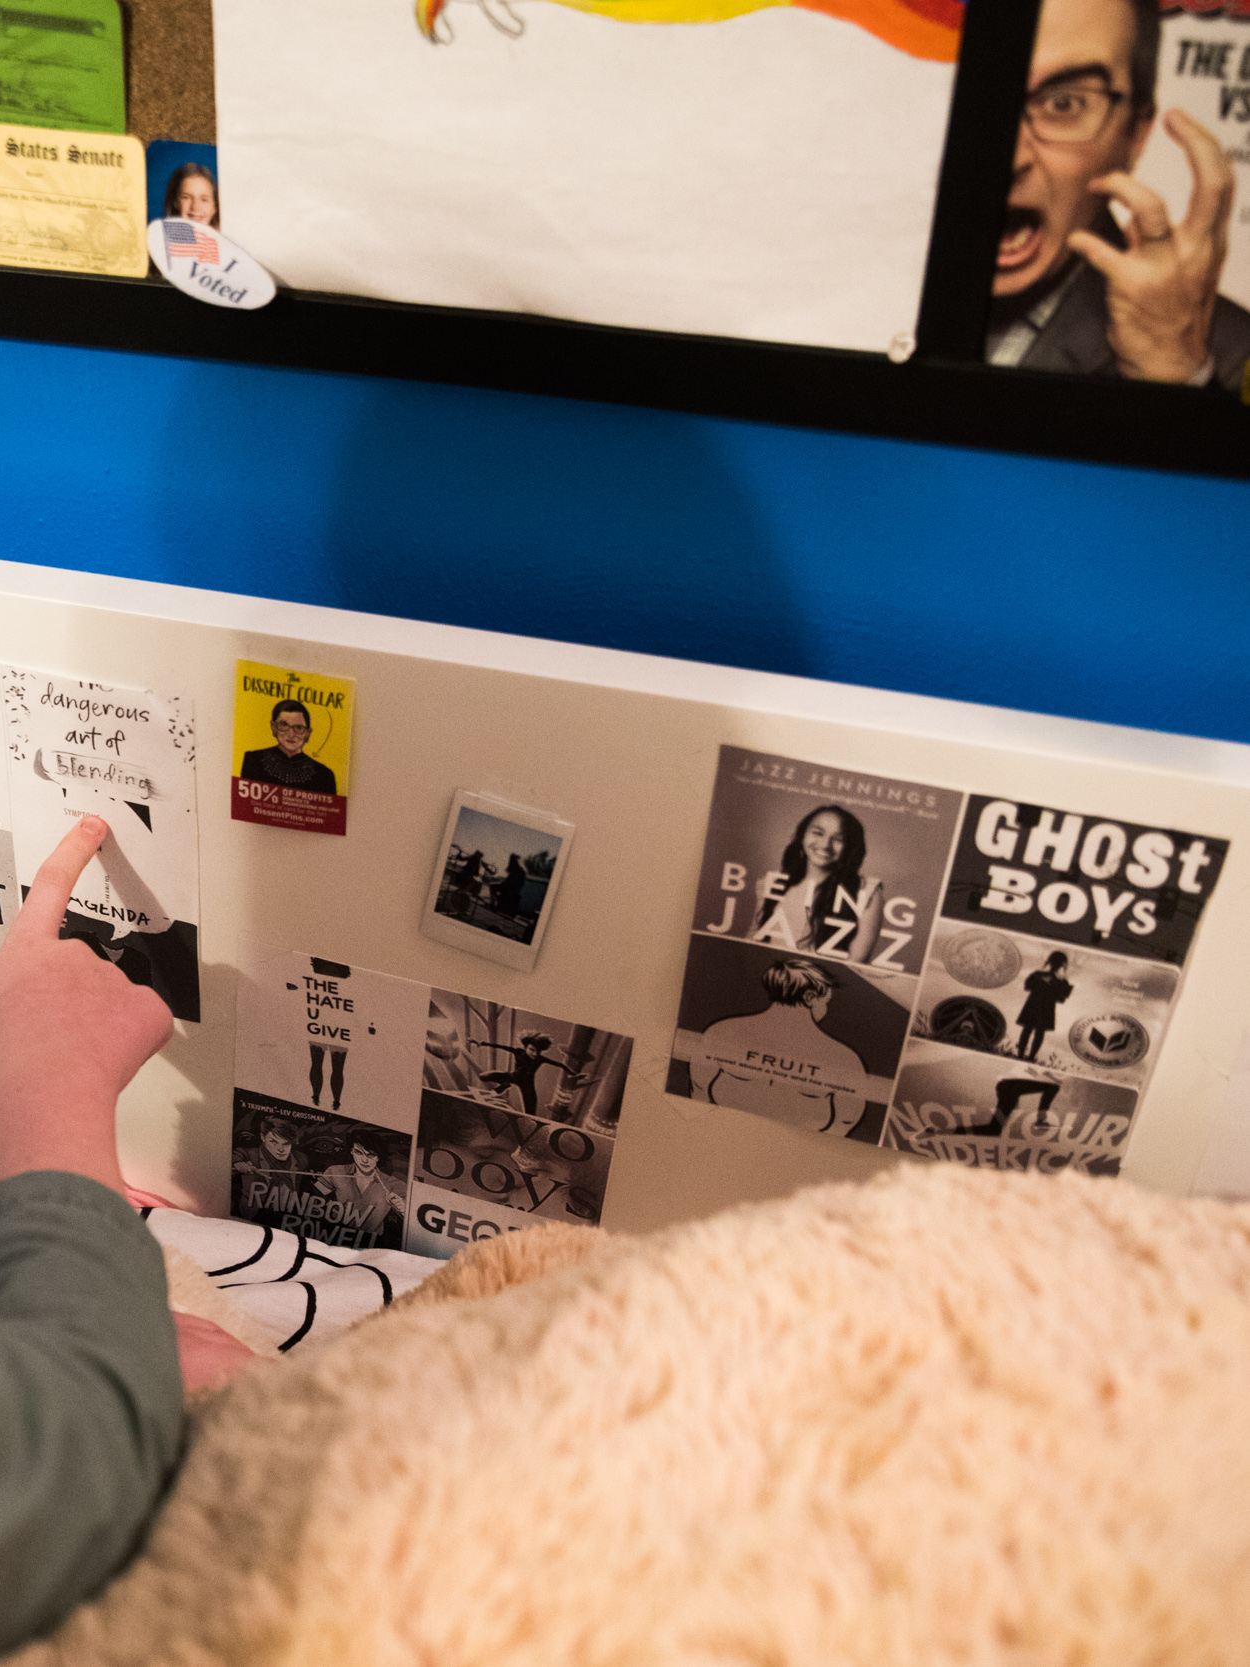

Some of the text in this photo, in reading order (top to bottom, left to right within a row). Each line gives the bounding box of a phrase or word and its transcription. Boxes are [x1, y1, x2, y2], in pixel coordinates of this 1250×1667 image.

[1177, 39, 1231, 80] THE
[5, 137, 59, 162] States
[65, 143, 125, 168] Senate
[223, 257, 238, 273] I
[189, 261, 248, 304] Voted
[40, 681, 150, 722] dangerous
[243, 675, 345, 710] DISSENT COLLAR
[65, 726, 126, 756] art of
[56, 754, 153, 800] blending
[238, 780, 333, 804] 50% OF PROFITS
[740, 758, 797, 780] JAZZ
[807, 770, 938, 808] JENNINGS
[253, 807, 324, 825] DissentPins.com
[720, 861, 917, 928] BEING
[706, 897, 913, 972] JAZZ
[302, 976, 338, 995] THE
[306, 992, 354, 1013] HATE
[307, 1007, 320, 1020] U
[306, 1022, 351, 1042] GIVE
[713, 1057, 737, 1065] novel
[738, 1062, 763, 1072] about
[772, 1070, 788, 1079] boy
[790, 1074, 807, 1083] and
[824, 1082, 856, 1094] nipples
[746, 1051, 820, 1077] FRUIT
[292, 1111, 325, 1122] GROSSMAN
[247, 1181, 375, 1228] RAINBOW
[417, 1203, 520, 1243] GEO
